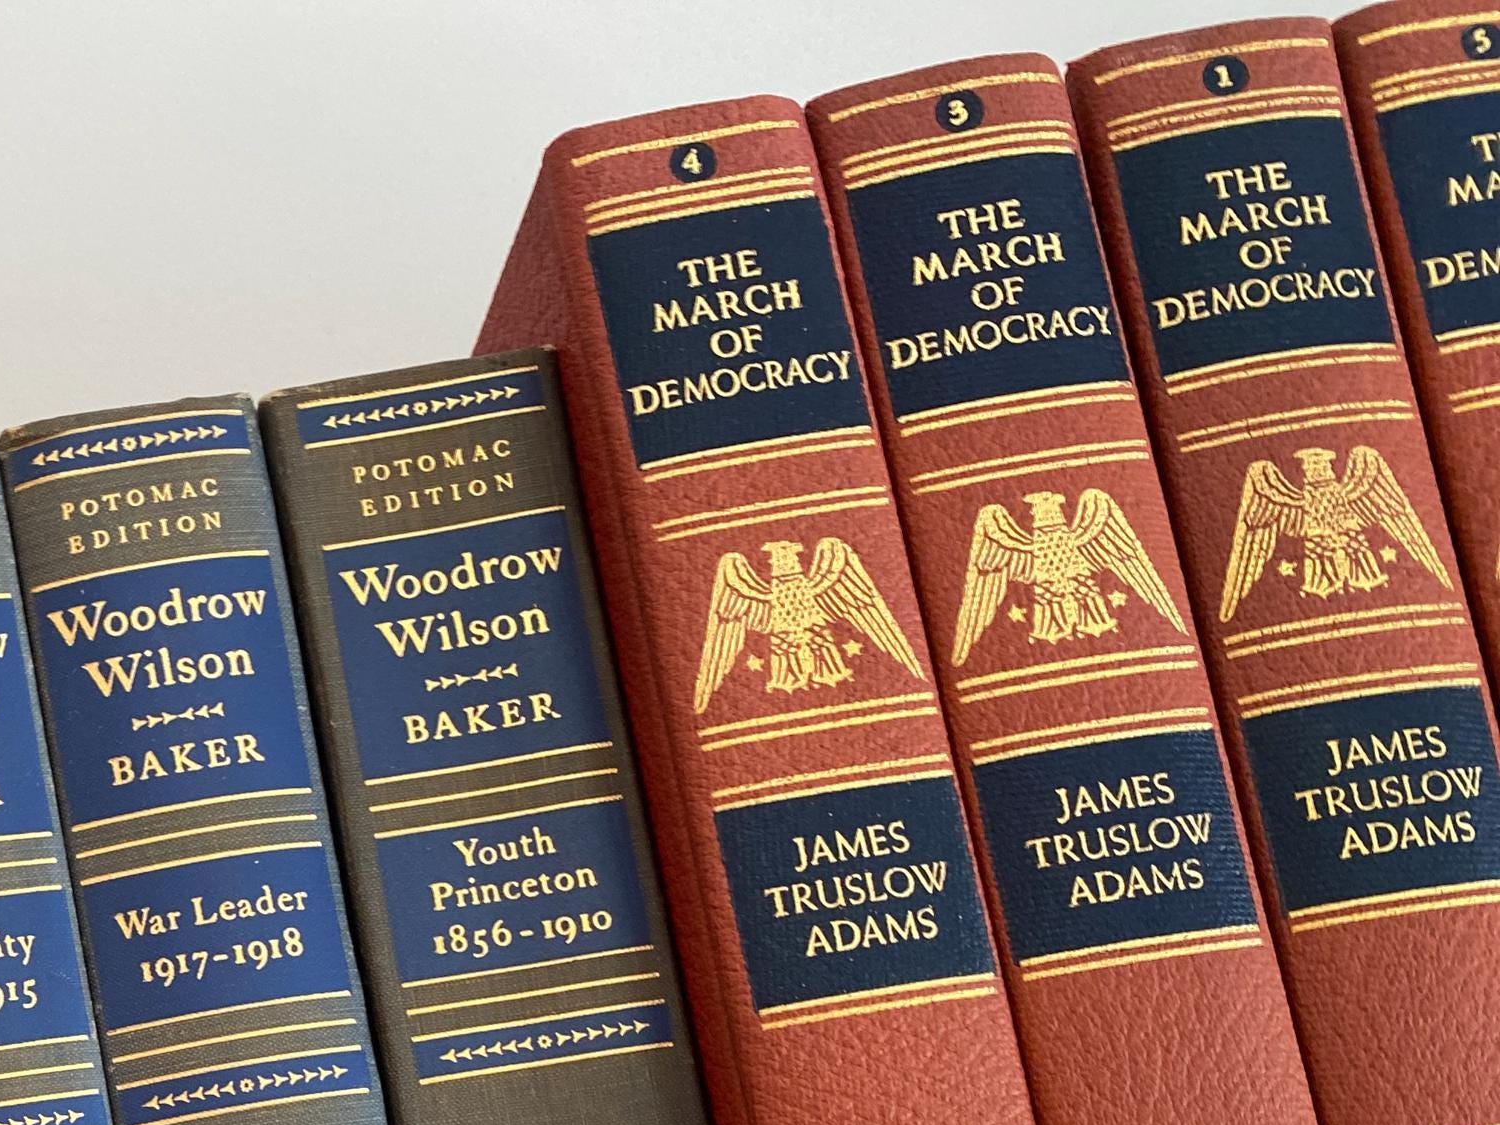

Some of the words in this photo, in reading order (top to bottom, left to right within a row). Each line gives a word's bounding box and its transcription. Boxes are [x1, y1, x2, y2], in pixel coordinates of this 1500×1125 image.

[1213, 65, 1234, 88] 1
[948, 99, 969, 126] 3
[681, 148, 702, 175] 4
[1205, 161, 1292, 200] THE
[936, 198, 1024, 240] THE
[1180, 194, 1332, 245] MARCH
[677, 249, 762, 288] THE
[912, 232, 1066, 286] MARCH
[1239, 235, 1293, 270] OF
[653, 279, 803, 333] MARCH
[970, 276, 1025, 311] OF
[1152, 268, 1376, 329] DEMOCRACY
[710, 324, 763, 359] OF
[885, 305, 1112, 370] DEMOCRACY
[626, 350, 851, 416] DEMOCRACY
[351, 439, 514, 484] POTOMAC
[60, 478, 219, 521] POTOMAC
[359, 472, 514, 517] EDITION
[68, 511, 222, 554] EDITION
[338, 547, 562, 606] Woodrow
[46, 587, 267, 647] Woodrow
[373, 605, 550, 658] Wilson
[81, 646, 255, 698] Wilson
[402, 692, 562, 744] BAKER
[107, 734, 266, 786] BAKER
[1326, 725, 1447, 777] JAMES
[1054, 772, 1175, 825] JAMES
[1294, 766, 1483, 821] TRUSLOW
[452, 826, 557, 867] Youth
[792, 820, 910, 873] JAMES
[1025, 812, 1212, 869] TRUSLOW
[1340, 810, 1476, 860] ADAMS
[429, 867, 598, 912] Princeton
[764, 860, 947, 918] TRUSLOW
[1069, 858, 1204, 908] ADAMS
[113, 906, 182, 940] War
[190, 884, 308, 926] Leader
[805, 904, 939, 958] ADAMS
[140, 927, 304, 987] 1917-1918
